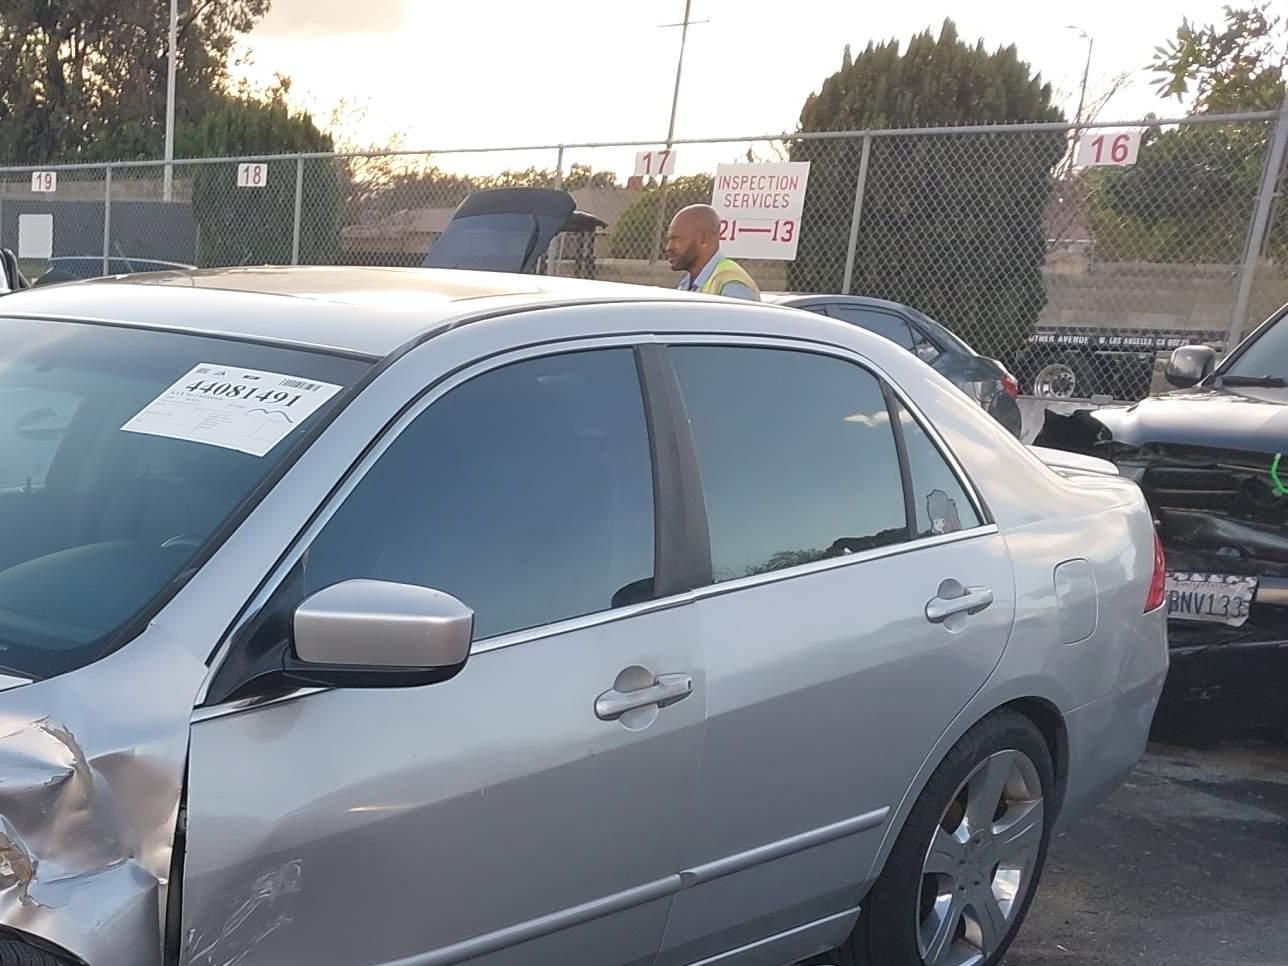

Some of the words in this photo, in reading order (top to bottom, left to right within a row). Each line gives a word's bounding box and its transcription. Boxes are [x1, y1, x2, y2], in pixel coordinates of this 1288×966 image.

[1091, 133, 1130, 163] 16
[642, 150, 670, 175] 17
[36, 173, 52, 190] 19
[243, 165, 262, 185] 18
[718, 175, 799, 191] INSPECTION
[724, 193, 790, 209] SERVICES
[1057, 335, 1089, 345] AVENUE
[1109, 336, 1122, 345] LOS
[185, 380, 302, 408] 44081491
